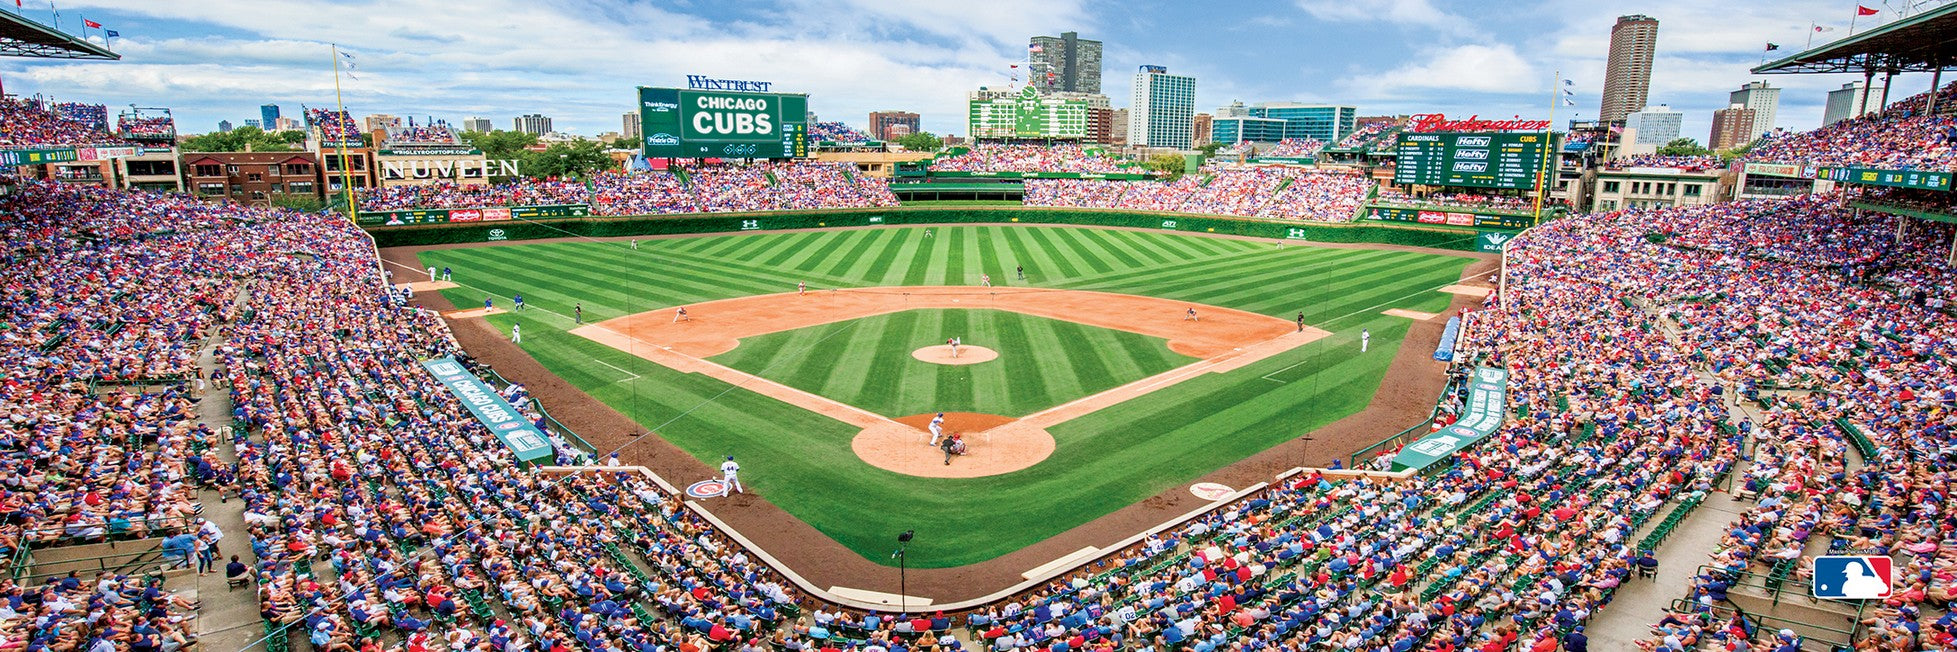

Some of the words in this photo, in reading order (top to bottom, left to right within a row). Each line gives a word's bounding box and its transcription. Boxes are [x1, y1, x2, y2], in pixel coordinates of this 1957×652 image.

[687, 75, 771, 92] WINTRUST
[697, 96, 767, 111] CHICAGO
[693, 111, 772, 135] CUBS
[1410, 113, 1551, 133] Budweiser
[1458, 138, 1488, 146] Hefty
[1519, 135, 1537, 143] CUBS
[1456, 150, 1486, 159] Hefty
[384, 160, 519, 179] NUVEEN
[1454, 163, 1484, 172] Hefty
[452, 380, 494, 406] CHICAGO
[479, 403, 514, 423] CUBS
[1125, 612, 1136, 620] 02
